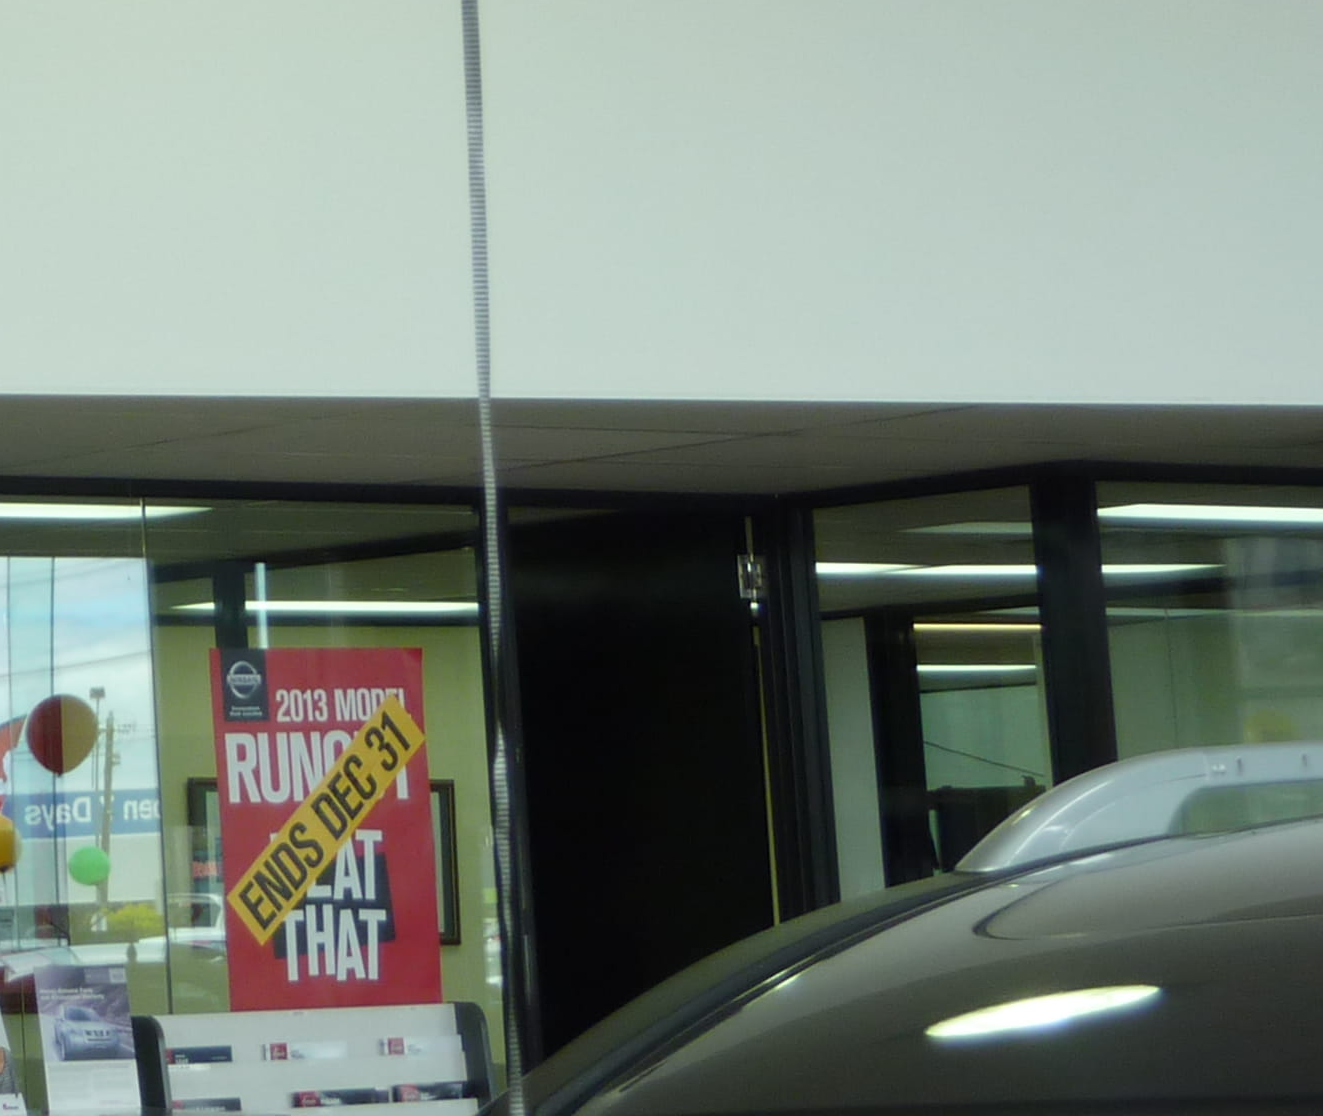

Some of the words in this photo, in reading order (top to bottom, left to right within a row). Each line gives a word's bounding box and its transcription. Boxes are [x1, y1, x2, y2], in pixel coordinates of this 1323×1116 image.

[275, 688, 329, 723] 2013
[333, 687, 405, 722] MOD
[224, 729, 409, 804] RUN
[238, 821, 325, 931] ENDS
[310, 754, 377, 841] DEC
[364, 710, 411, 772] 31
[283, 902, 387, 982] THAT
